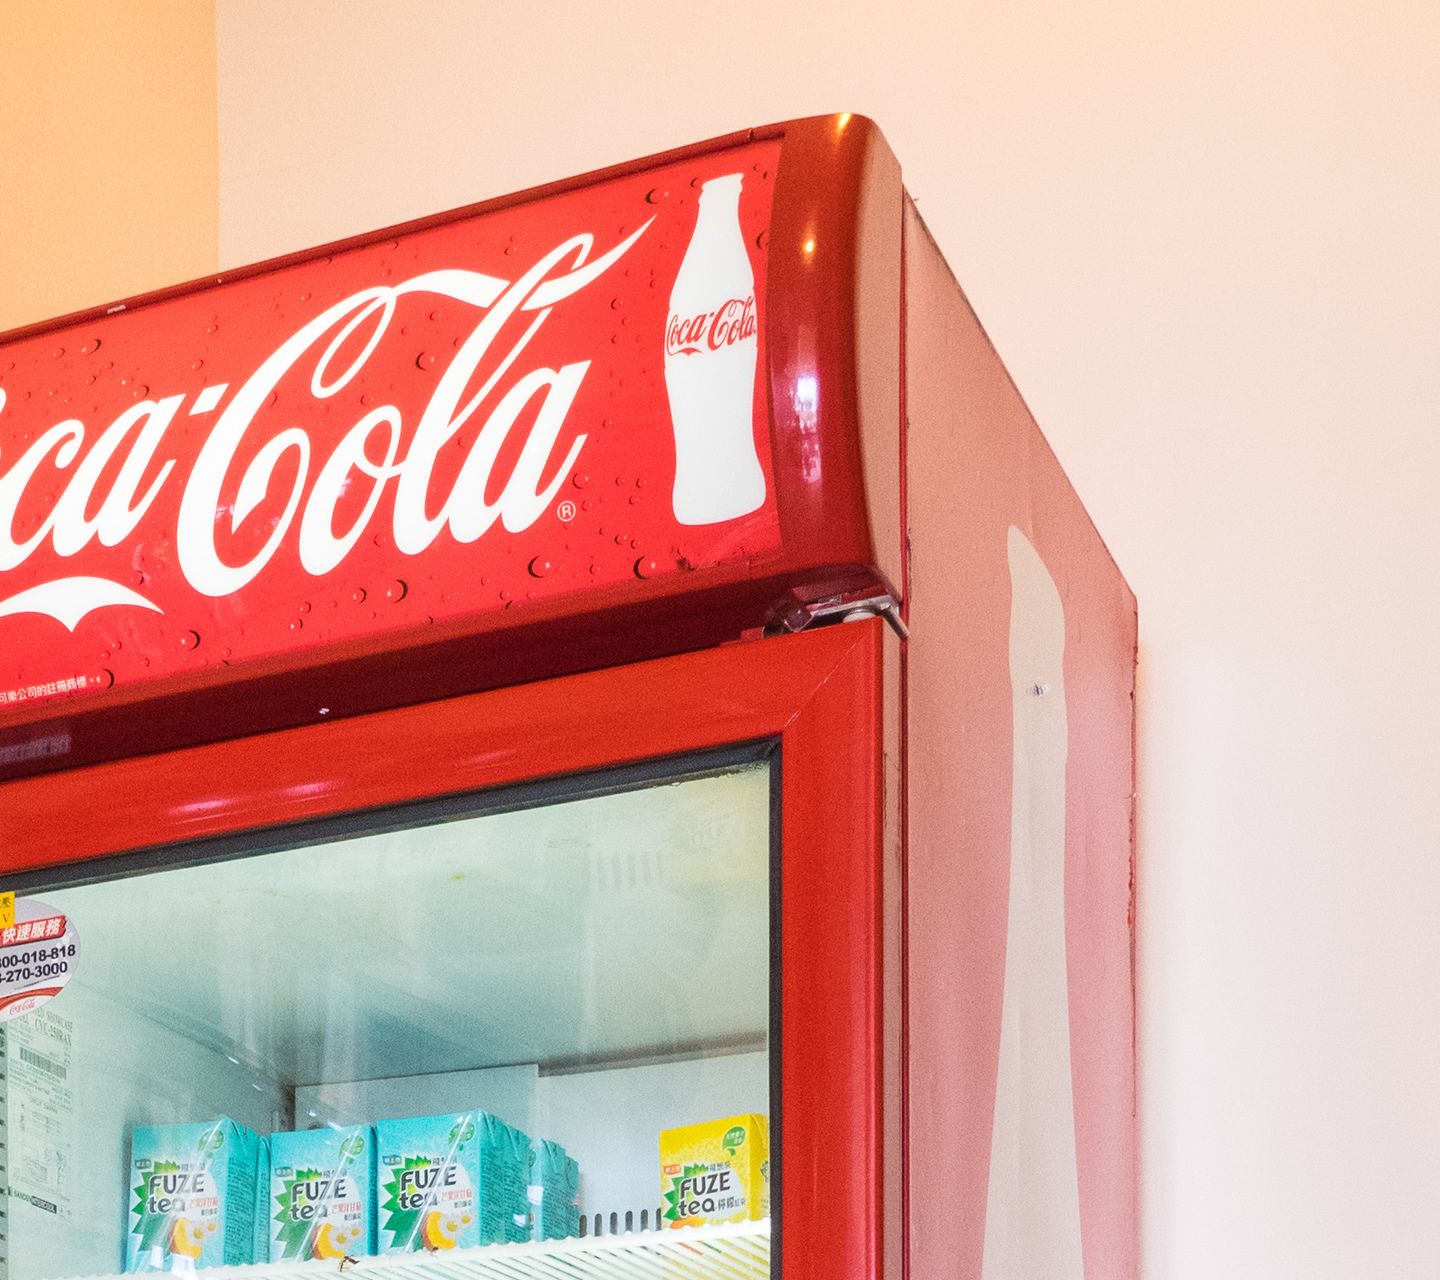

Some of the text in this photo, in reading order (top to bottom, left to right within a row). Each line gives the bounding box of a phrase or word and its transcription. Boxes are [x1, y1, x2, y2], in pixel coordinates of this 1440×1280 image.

[666, 296, 756, 356] Coca-Cola
[2, 913, 10, 922] V
[2, 919, 61, 945] 快速服務
[149, 1174, 205, 1195] FUZE
[401, 1166, 457, 1191] FUZE
[680, 1171, 731, 1200] FUZE
[293, 1180, 347, 1203] FUZE
[399, 1192, 438, 1209] tea
[148, 1198, 185, 1214] tea
[291, 1204, 329, 1220] tea
[679, 1198, 715, 1216] tea
